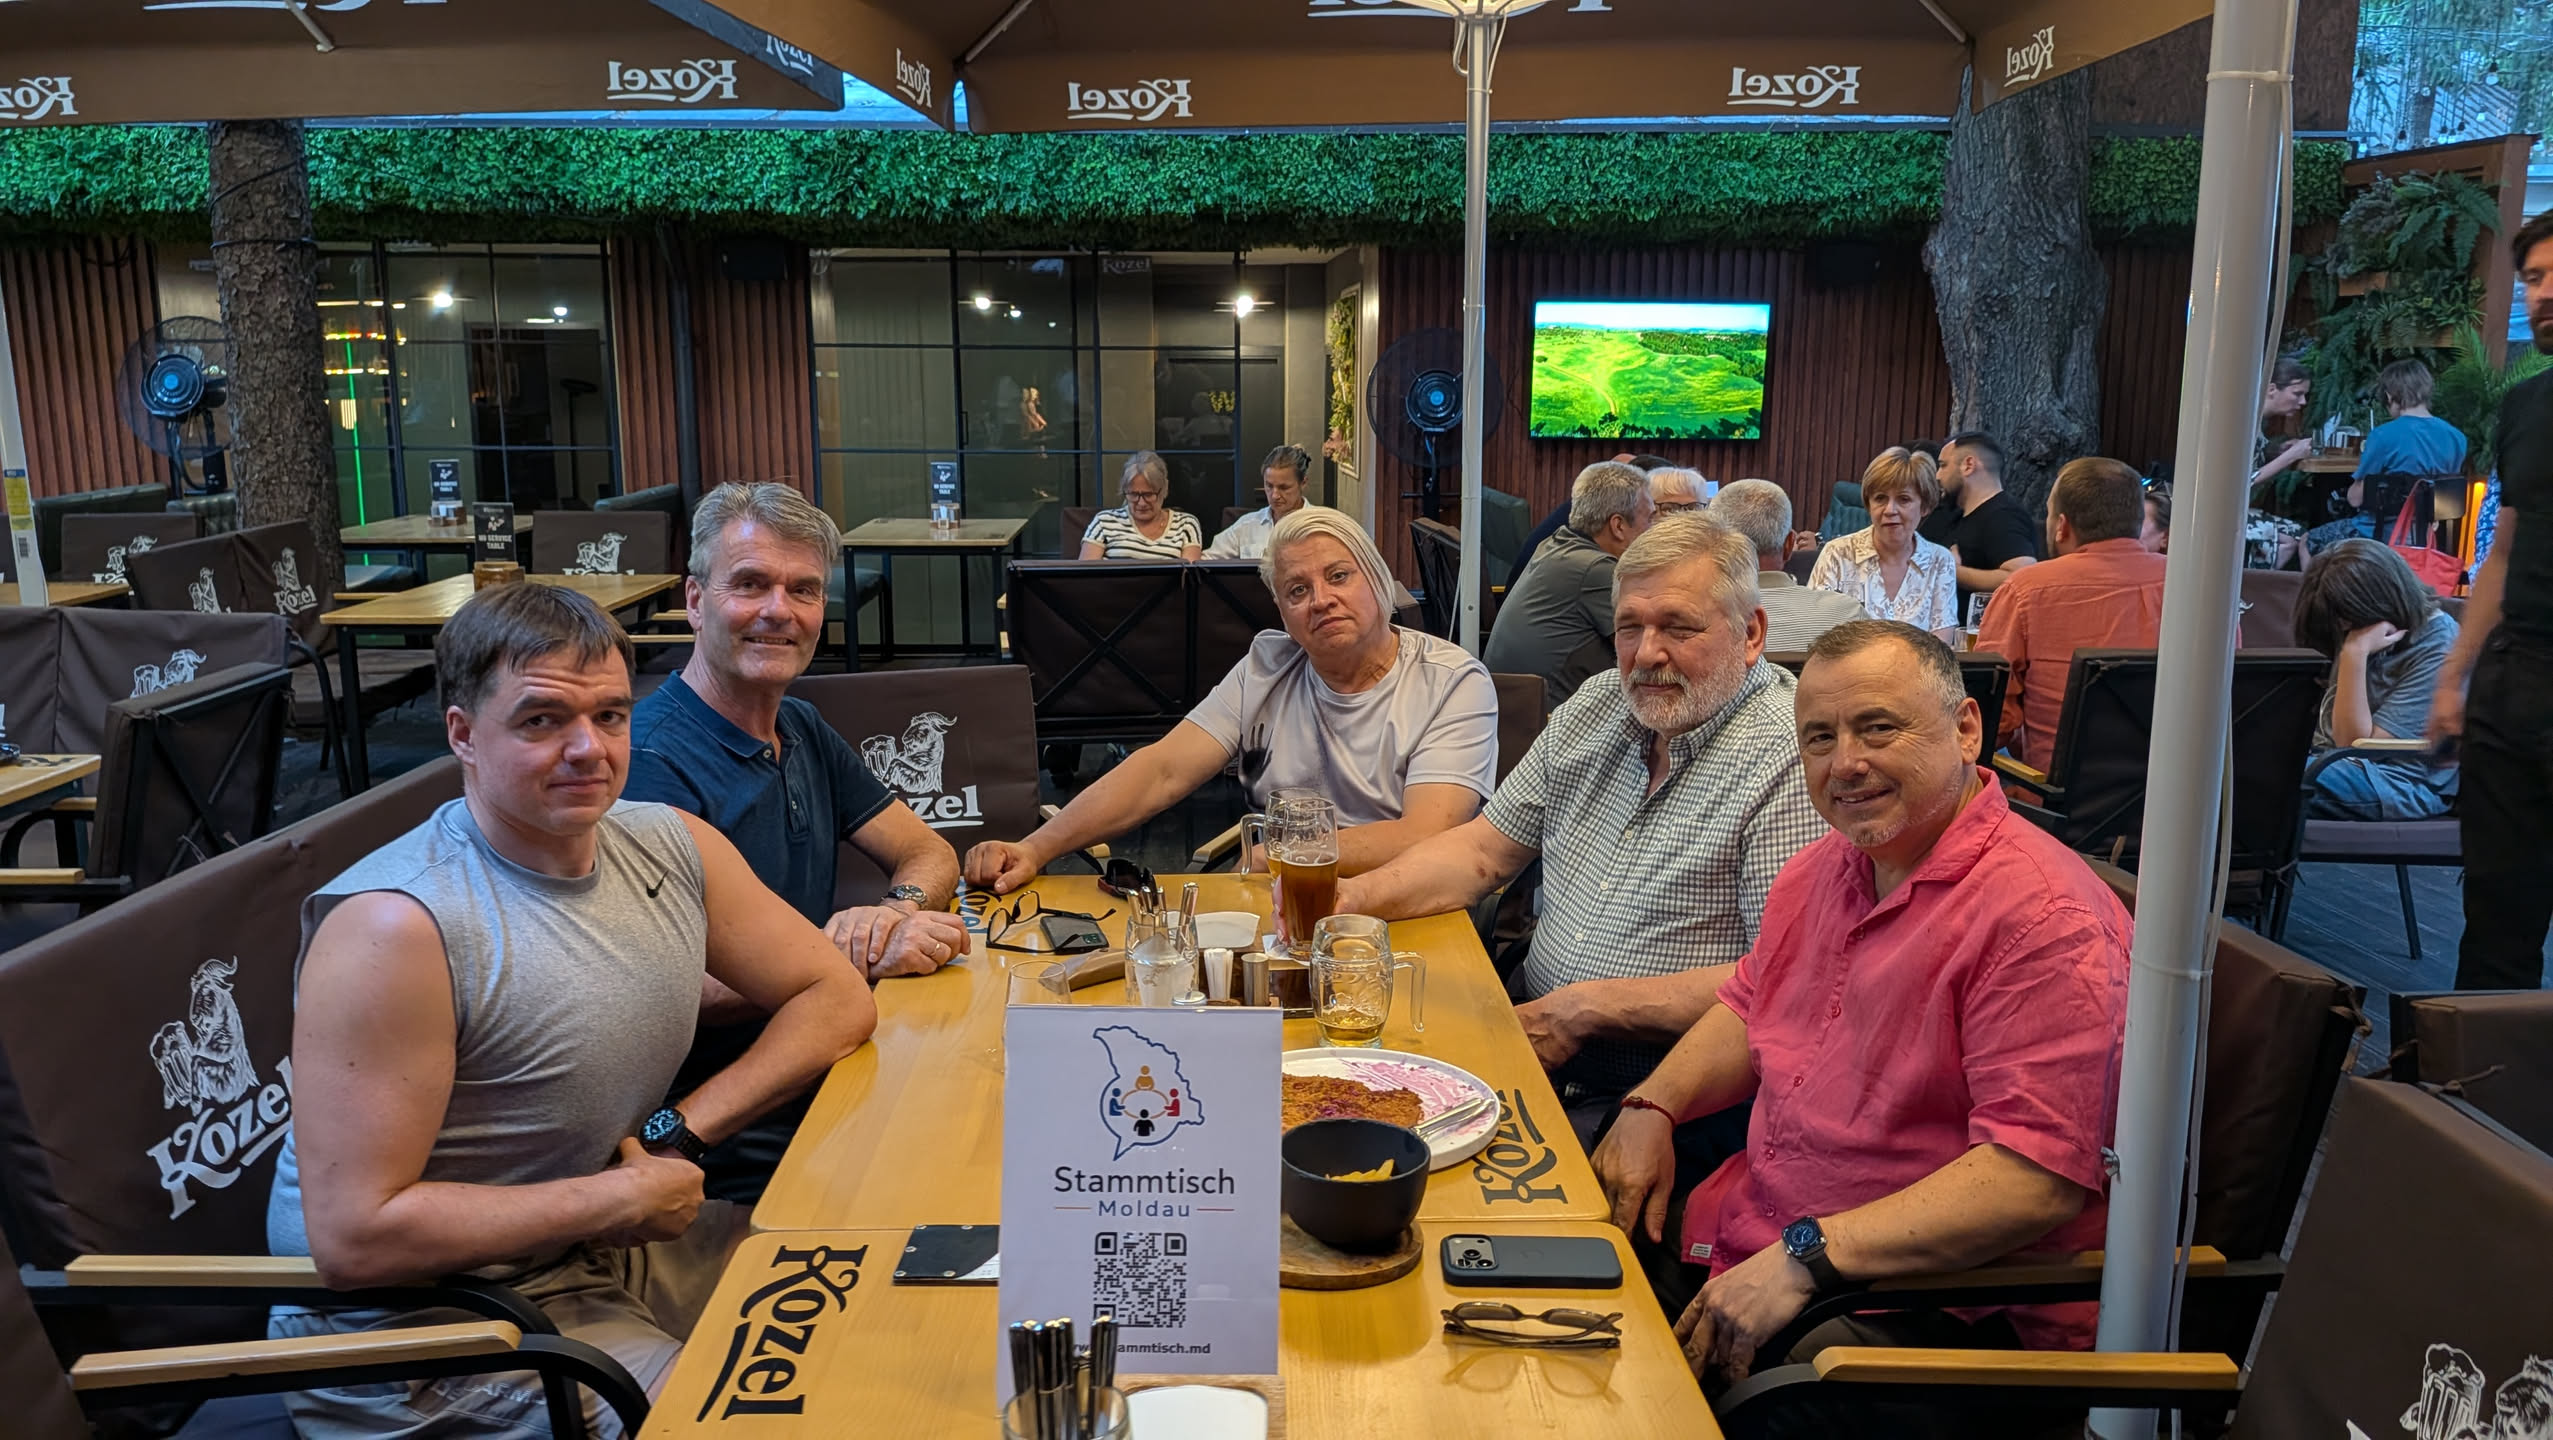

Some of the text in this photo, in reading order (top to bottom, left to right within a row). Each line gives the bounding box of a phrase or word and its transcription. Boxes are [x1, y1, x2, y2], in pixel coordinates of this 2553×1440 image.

[907, 785, 983, 821] zel
[1054, 1166, 1235, 1194] Stammtisch
[1098, 1200, 1190, 1217] Moldau
[697, 1245, 869, 1422] Kozel
